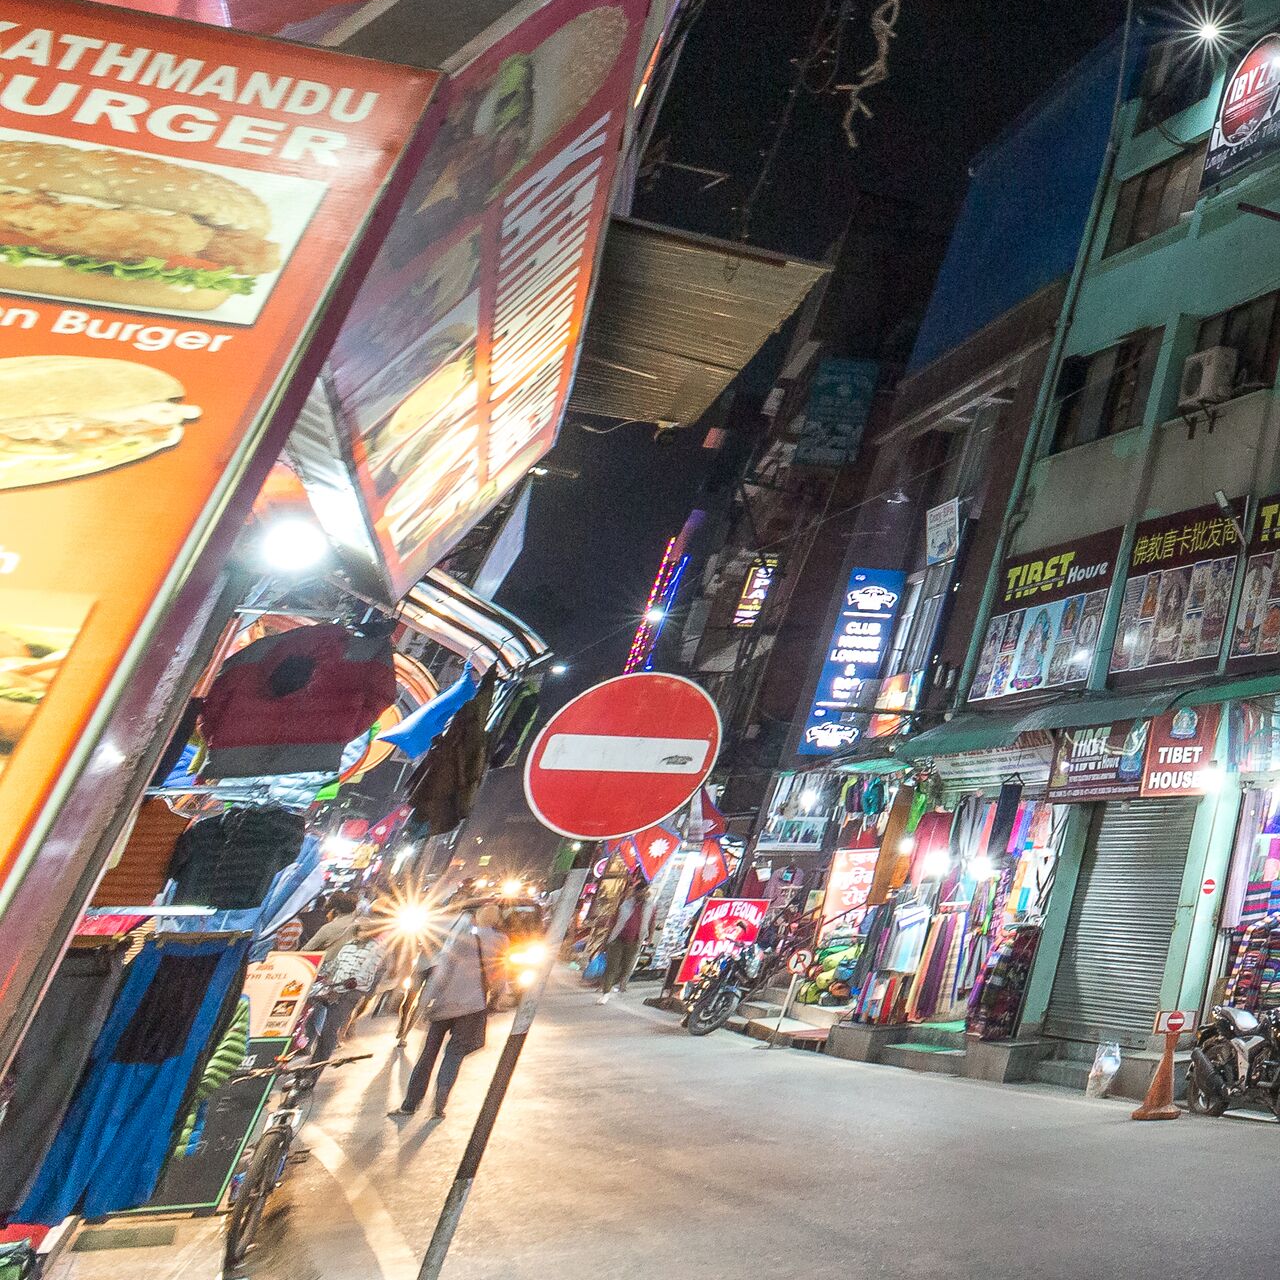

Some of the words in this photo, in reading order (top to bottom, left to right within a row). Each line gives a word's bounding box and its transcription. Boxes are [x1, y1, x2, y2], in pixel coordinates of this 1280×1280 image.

[0, 22, 380, 123] ATHMANDU
[0, 74, 347, 168] URGER
[489, 110, 613, 402] KATHMANDU
[51, 309, 233, 353] Burger
[487, 344, 569, 482] BURGER
[1067, 561, 1108, 585] House
[1158, 745, 1204, 764] TIBET
[1149, 771, 1200, 789] HOUSE
[701, 902, 728, 926] CLUB
